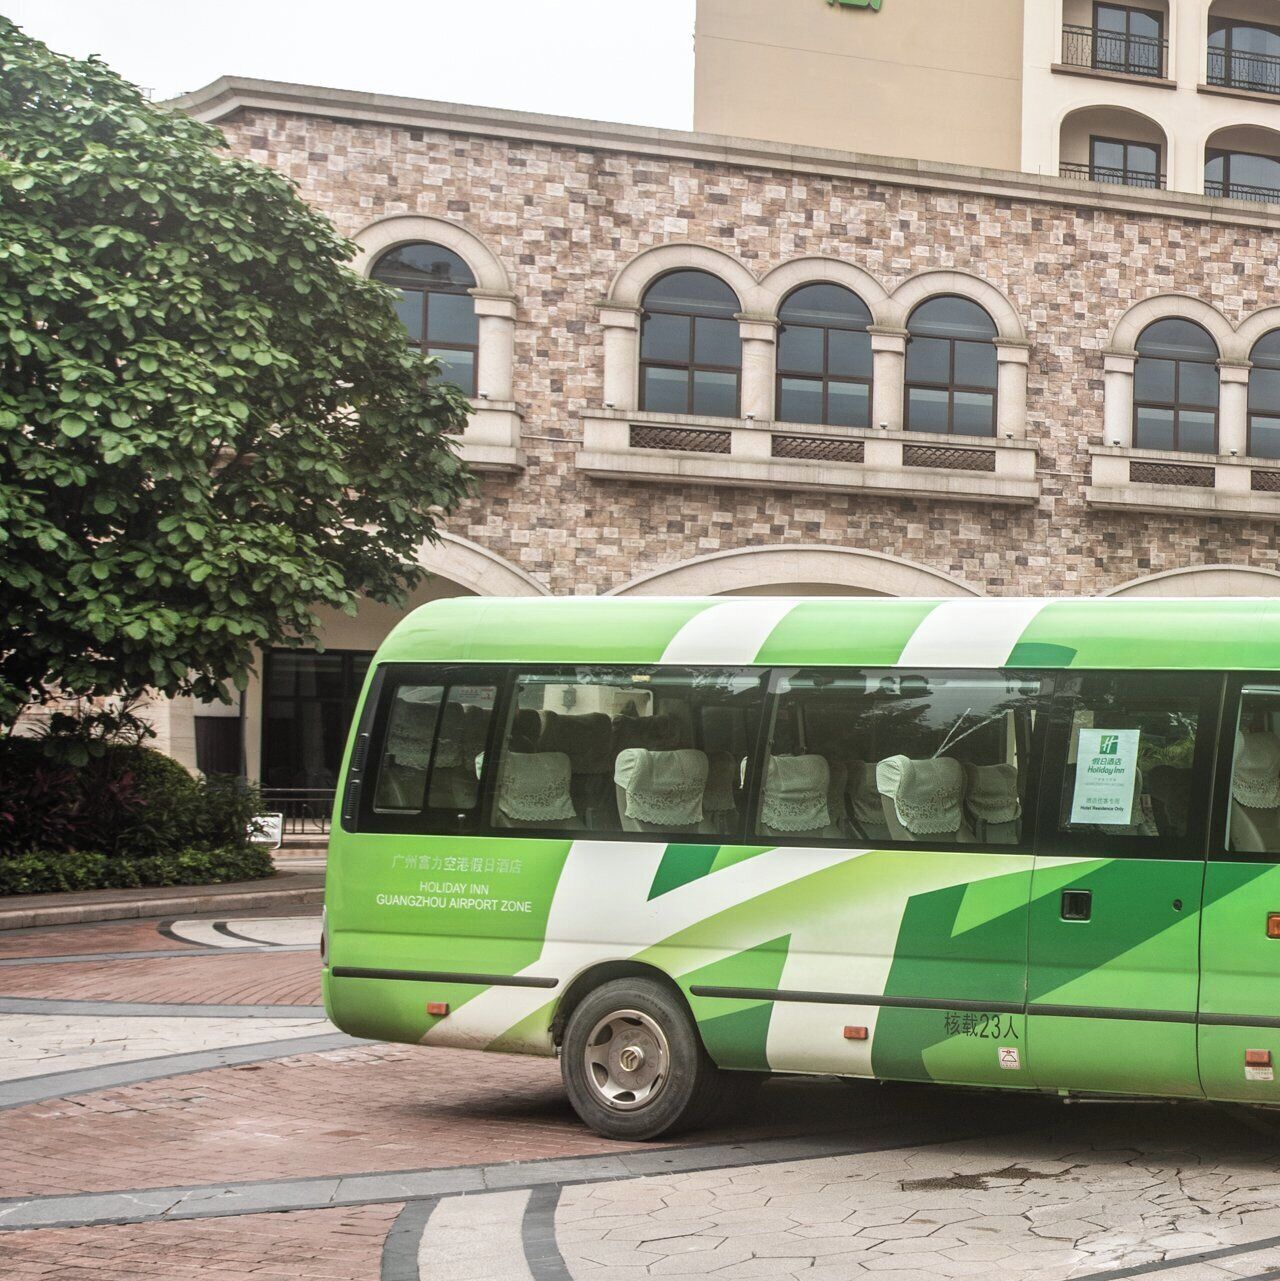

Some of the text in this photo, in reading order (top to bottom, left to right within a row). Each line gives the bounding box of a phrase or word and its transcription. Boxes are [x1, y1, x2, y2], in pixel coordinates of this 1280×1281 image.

[1087, 766, 1113, 775] Holiday
[392, 854, 523, 874] 广州富力空港假日酒店
[419, 881, 489, 895] HOLIDAY INN
[376, 893, 532, 913] GUANGZHOU AIRPORT ZONE
[944, 1011, 1019, 1039] 核载23人
